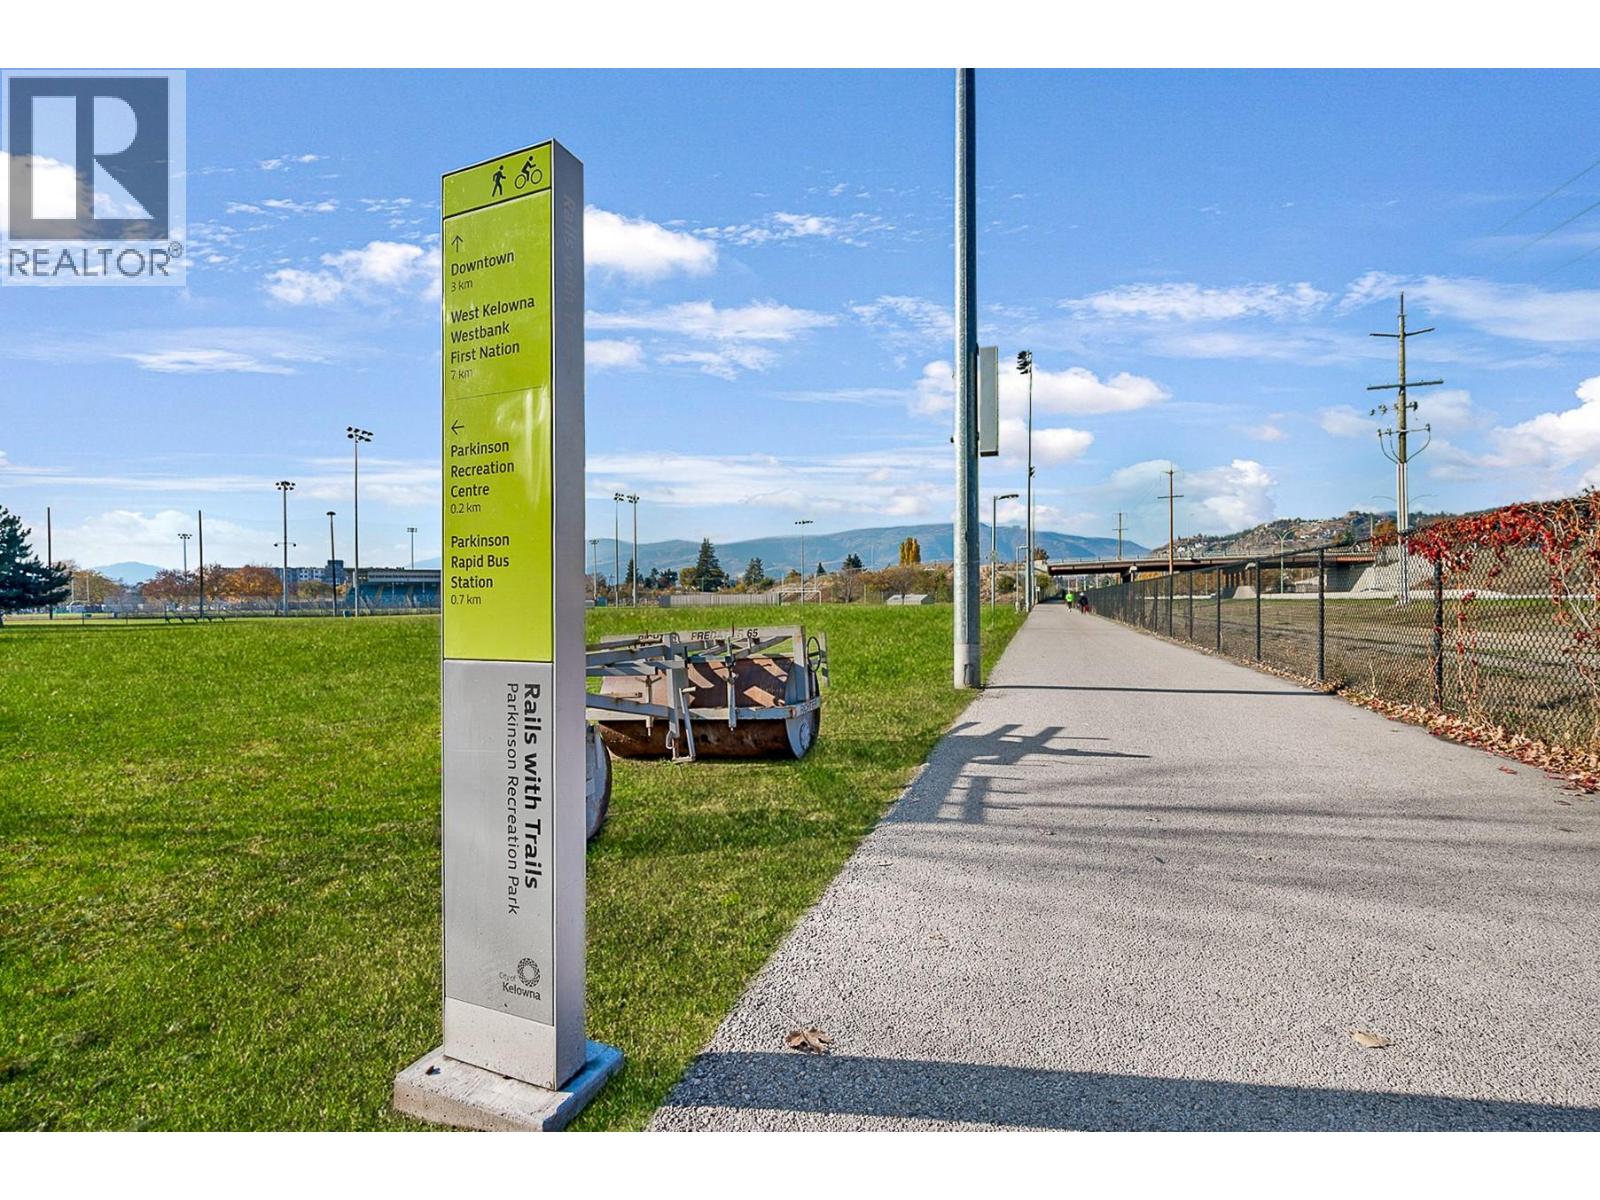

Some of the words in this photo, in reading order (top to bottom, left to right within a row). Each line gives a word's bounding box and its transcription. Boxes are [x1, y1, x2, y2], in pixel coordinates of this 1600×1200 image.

[451, 251, 515, 276] Downtown
[451, 281, 457, 293] 3
[458, 279, 473, 290] km
[451, 306, 480, 324] West
[482, 297, 535, 318] Kelowna
[451, 321, 510, 344] Westbank
[451, 349, 476, 364] First
[479, 342, 520, 359] Nation
[451, 369, 457, 380] 7
[458, 368, 473, 379] km
[451, 441, 509, 457] Parkinson
[451, 461, 514, 478] Recreation
[450, 484, 490, 498] Centre
[450, 503, 465, 514] 0.2
[466, 503, 481, 513] km
[451, 534, 510, 548] Parkinson
[451, 554, 484, 571] Rapid
[487, 555, 509, 568] Bus
[451, 576, 493, 589] Station
[450, 595, 465, 605] 0.7
[466, 594, 482, 605] km
[746, 628, 758, 639] 65
[524, 683, 542, 745] Rails
[507, 683, 519, 770] Parkinson
[524, 752, 542, 810] with
[507, 776, 519, 870] Recreation
[524, 819, 542, 889] Trails
[508, 875, 520, 915] Park
[502, 981, 541, 1000] Kelowna
